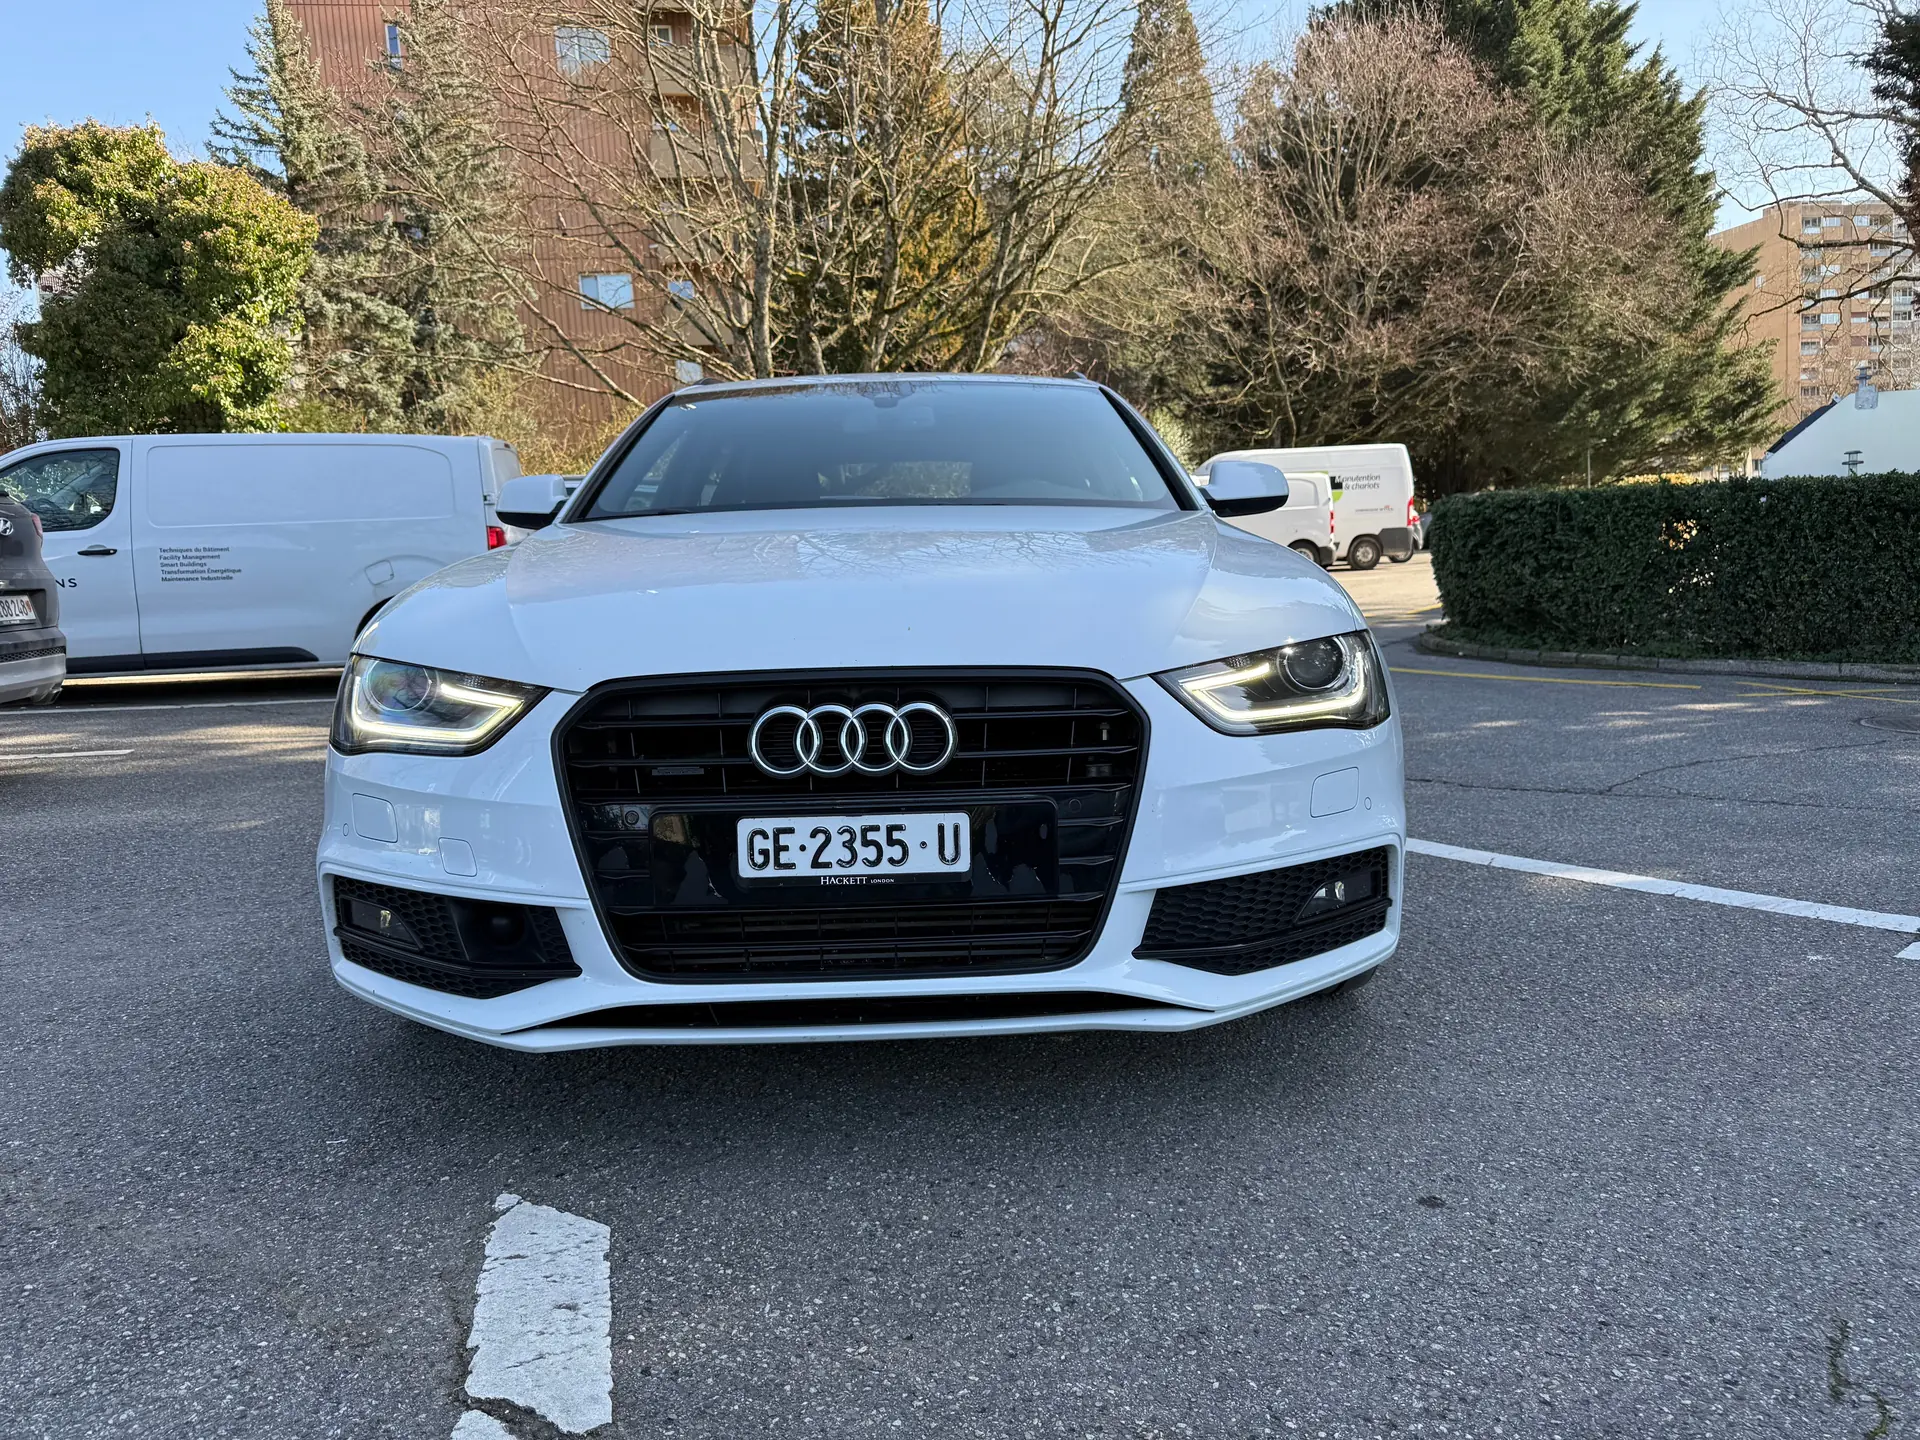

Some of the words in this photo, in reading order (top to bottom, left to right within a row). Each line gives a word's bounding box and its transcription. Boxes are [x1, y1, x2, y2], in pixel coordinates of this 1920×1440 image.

[1335, 474, 1380, 483] Manutention
[1351, 482, 1380, 490] chariots
[820, 876, 868, 885] HACKETT
